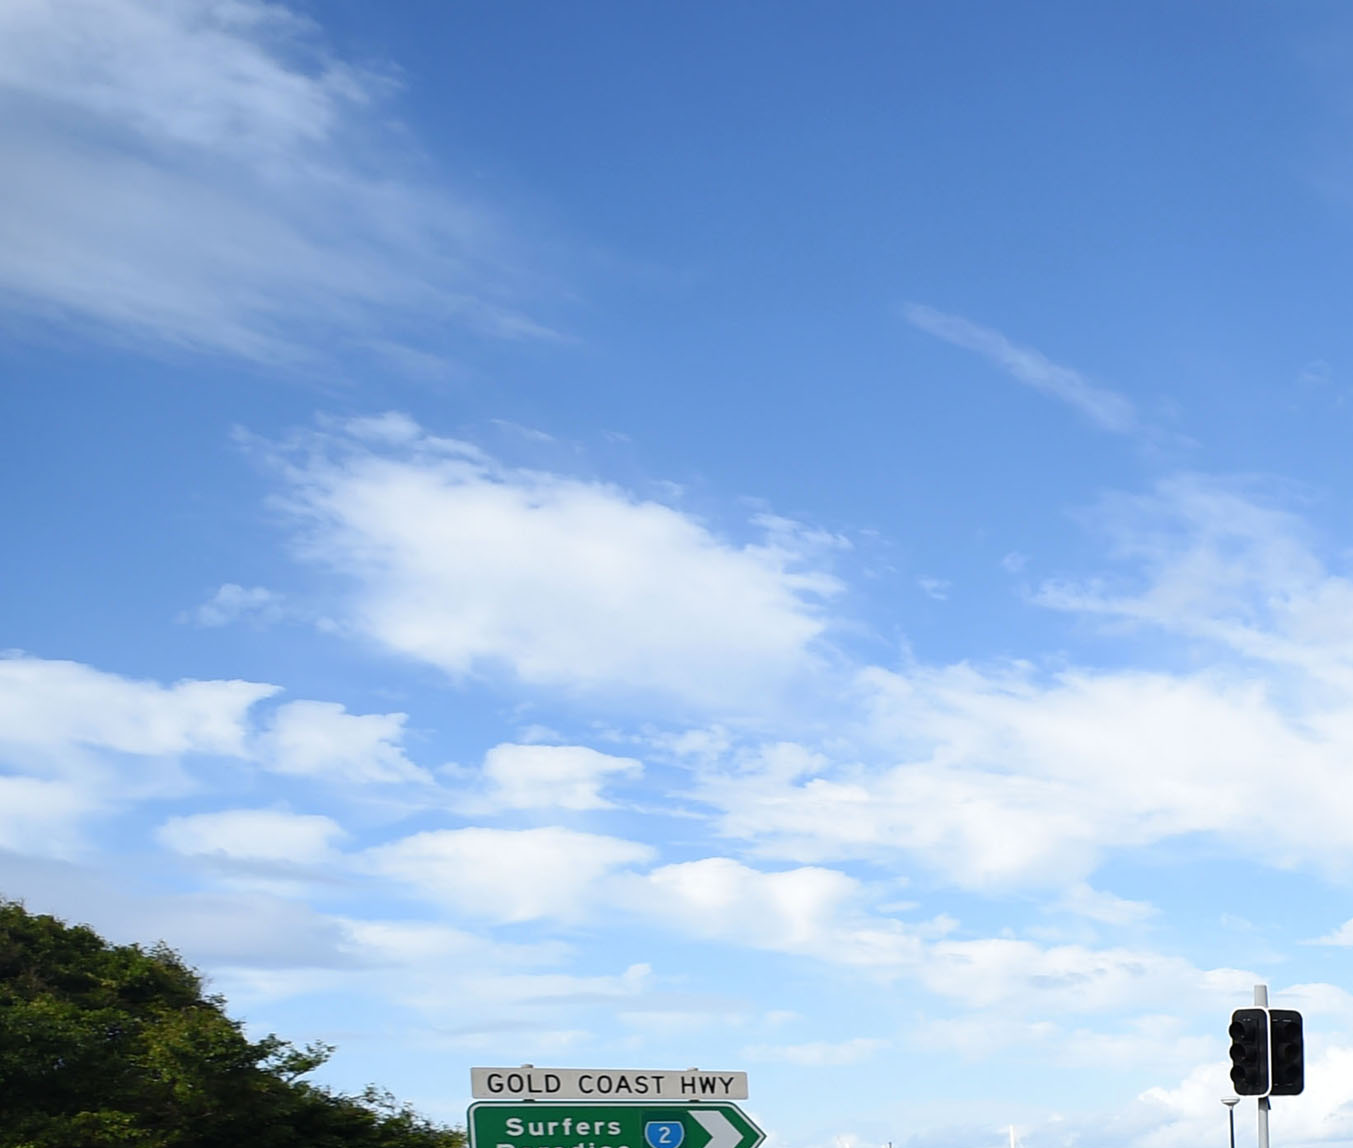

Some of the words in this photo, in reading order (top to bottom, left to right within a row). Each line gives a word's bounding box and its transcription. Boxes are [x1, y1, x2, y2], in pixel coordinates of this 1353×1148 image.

[487, 1073, 561, 1093] GOLD
[578, 1074, 665, 1094] COAST
[681, 1075, 735, 1095] HWY
[505, 1117, 621, 1137] Surfers
[658, 1126, 672, 1144] 2
